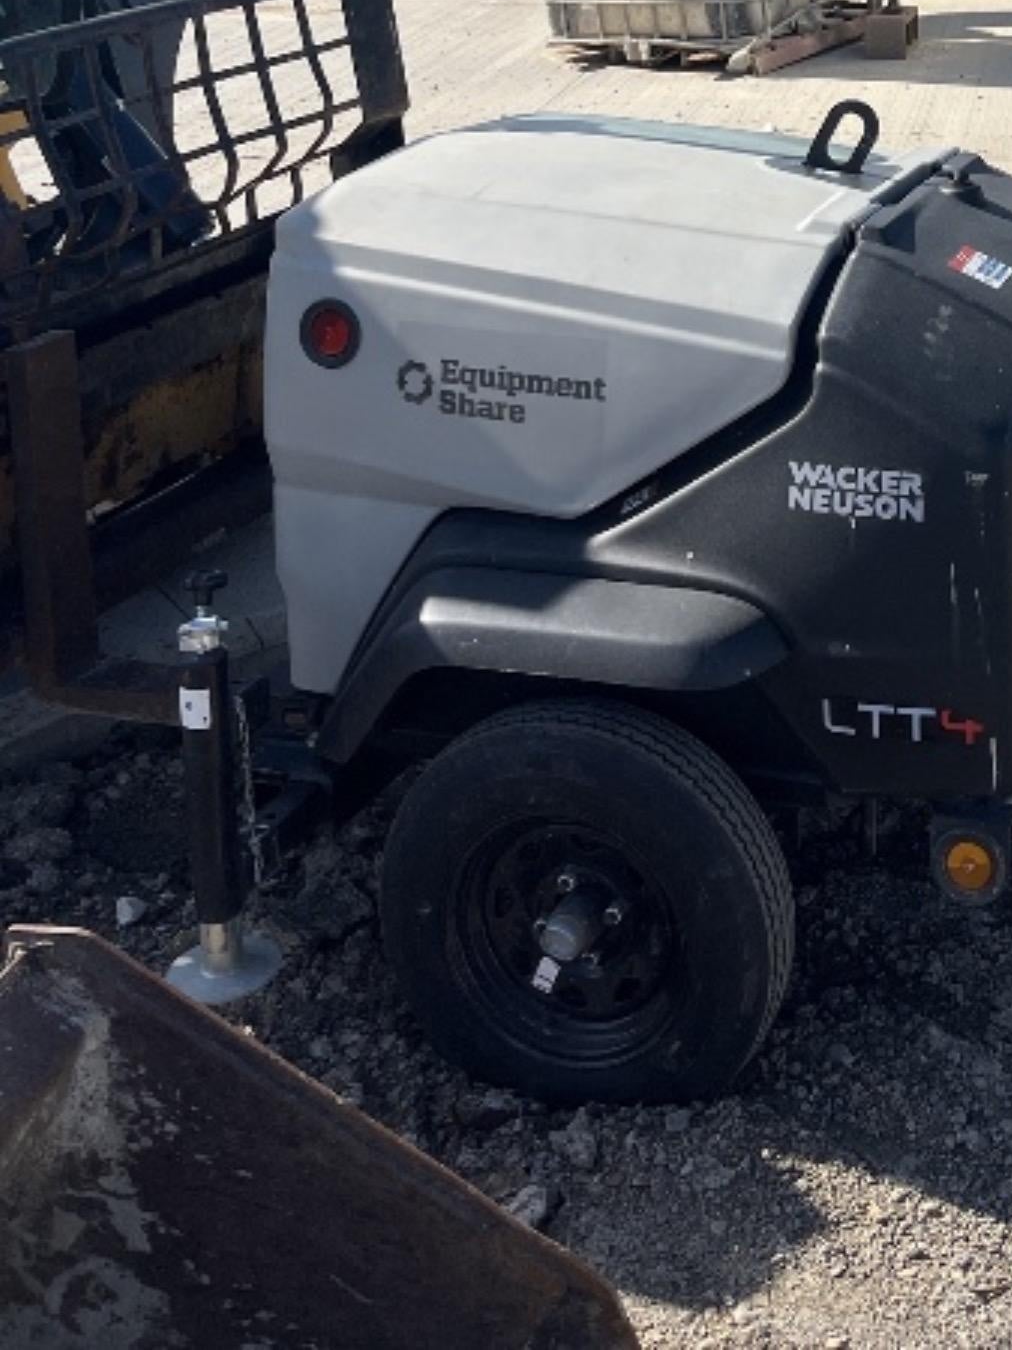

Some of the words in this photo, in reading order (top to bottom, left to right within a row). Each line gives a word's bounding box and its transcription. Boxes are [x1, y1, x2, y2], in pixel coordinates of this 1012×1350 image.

[440, 359, 607, 402] Equipment
[438, 389, 526, 423] Share
[788, 461, 922, 496] WACKER
[788, 485, 925, 523] NEUSON
[822, 698, 984, 745] LTT4
